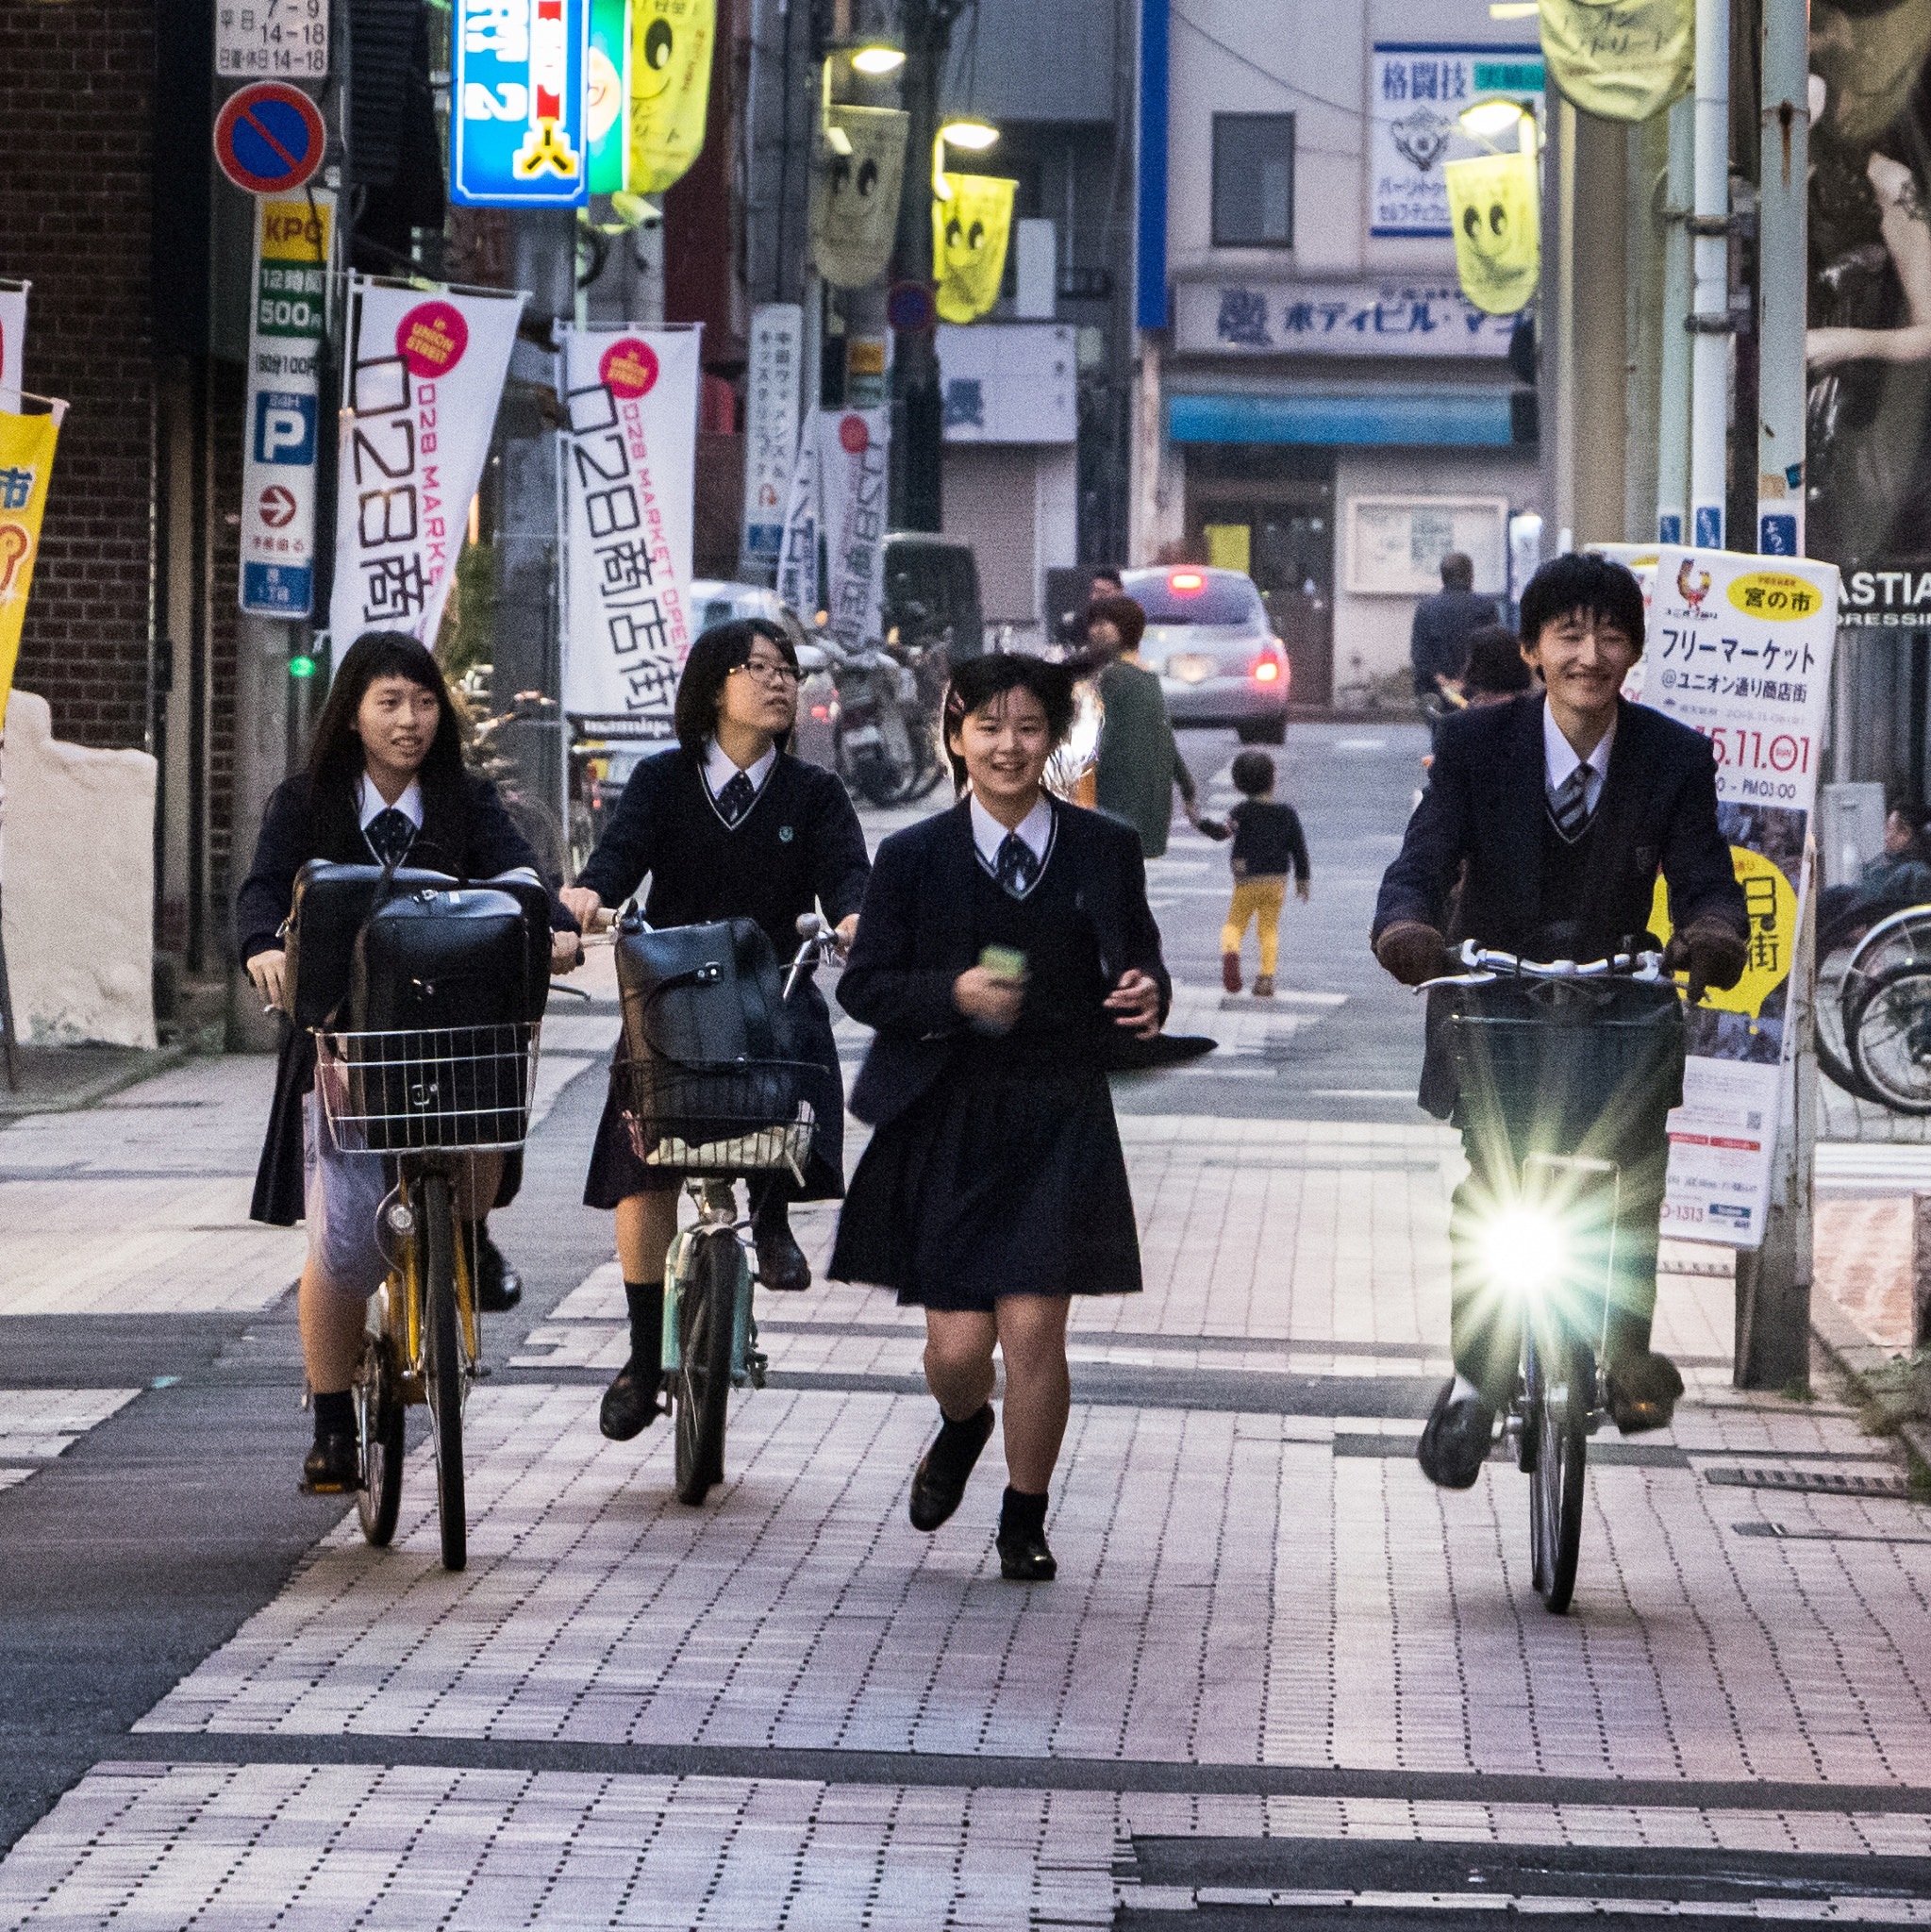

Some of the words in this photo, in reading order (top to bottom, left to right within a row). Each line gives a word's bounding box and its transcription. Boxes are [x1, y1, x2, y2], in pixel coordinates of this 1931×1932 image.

[261, 23, 324, 44] 14-18
[274, 49, 324, 70] 14-18
[465, 82, 528, 121] 2
[263, 408, 306, 459] P
[422, 464, 447, 587] MARKE
[568, 382, 679, 711] 028商店街
[638, 467, 675, 580] MARKET
[660, 589, 690, 662] OPEN
[1745, 587, 1813, 611] 宮の市
[1662, 628, 1815, 674] フリーマーケット
[1661, 668, 1807, 704] @ユニオン通り商店街
[1695, 725, 1810, 773] 5.11.01
